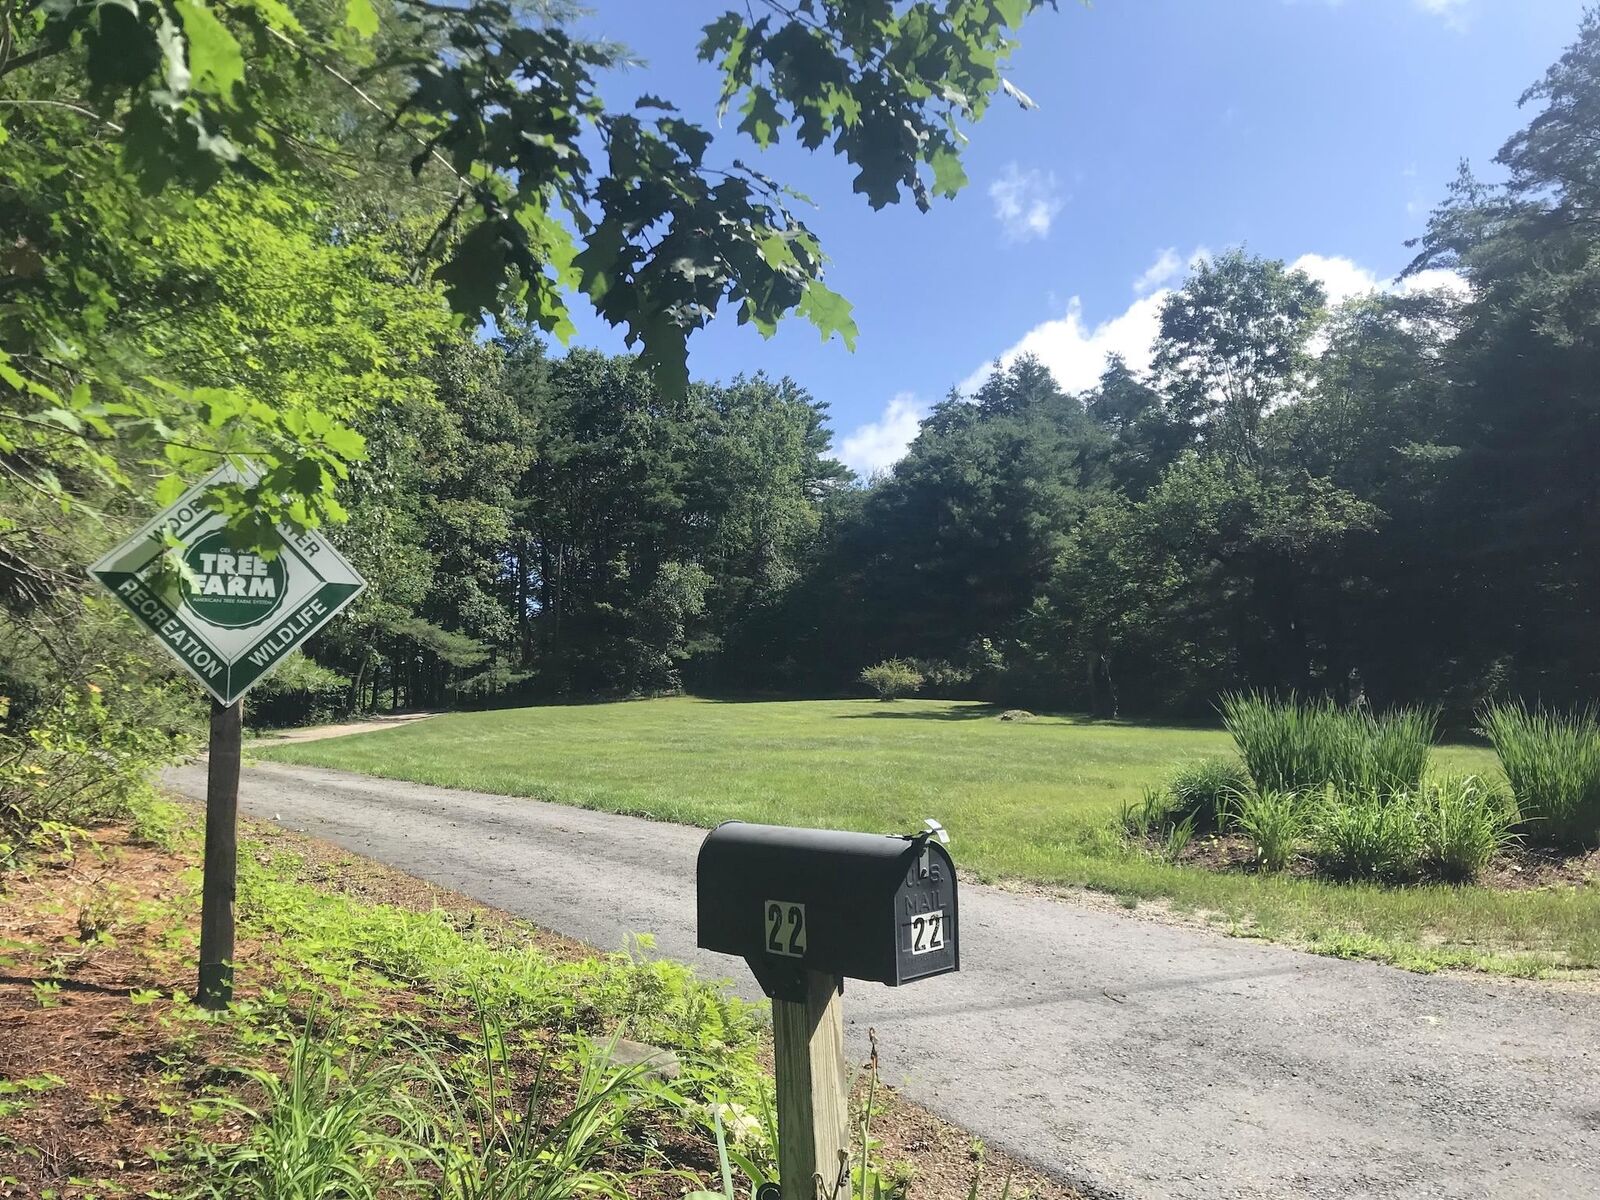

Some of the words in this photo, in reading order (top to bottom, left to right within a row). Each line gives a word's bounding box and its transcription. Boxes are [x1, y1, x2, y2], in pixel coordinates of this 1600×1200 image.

[200, 553, 268, 576] TREE
[191, 574, 276, 597] FARM
[117, 579, 223, 679] RECREATION
[248, 598, 328, 667] WILDLIFE
[905, 890, 947, 915] MAIL
[768, 903, 804, 954] 22
[913, 914, 942, 952] 22
